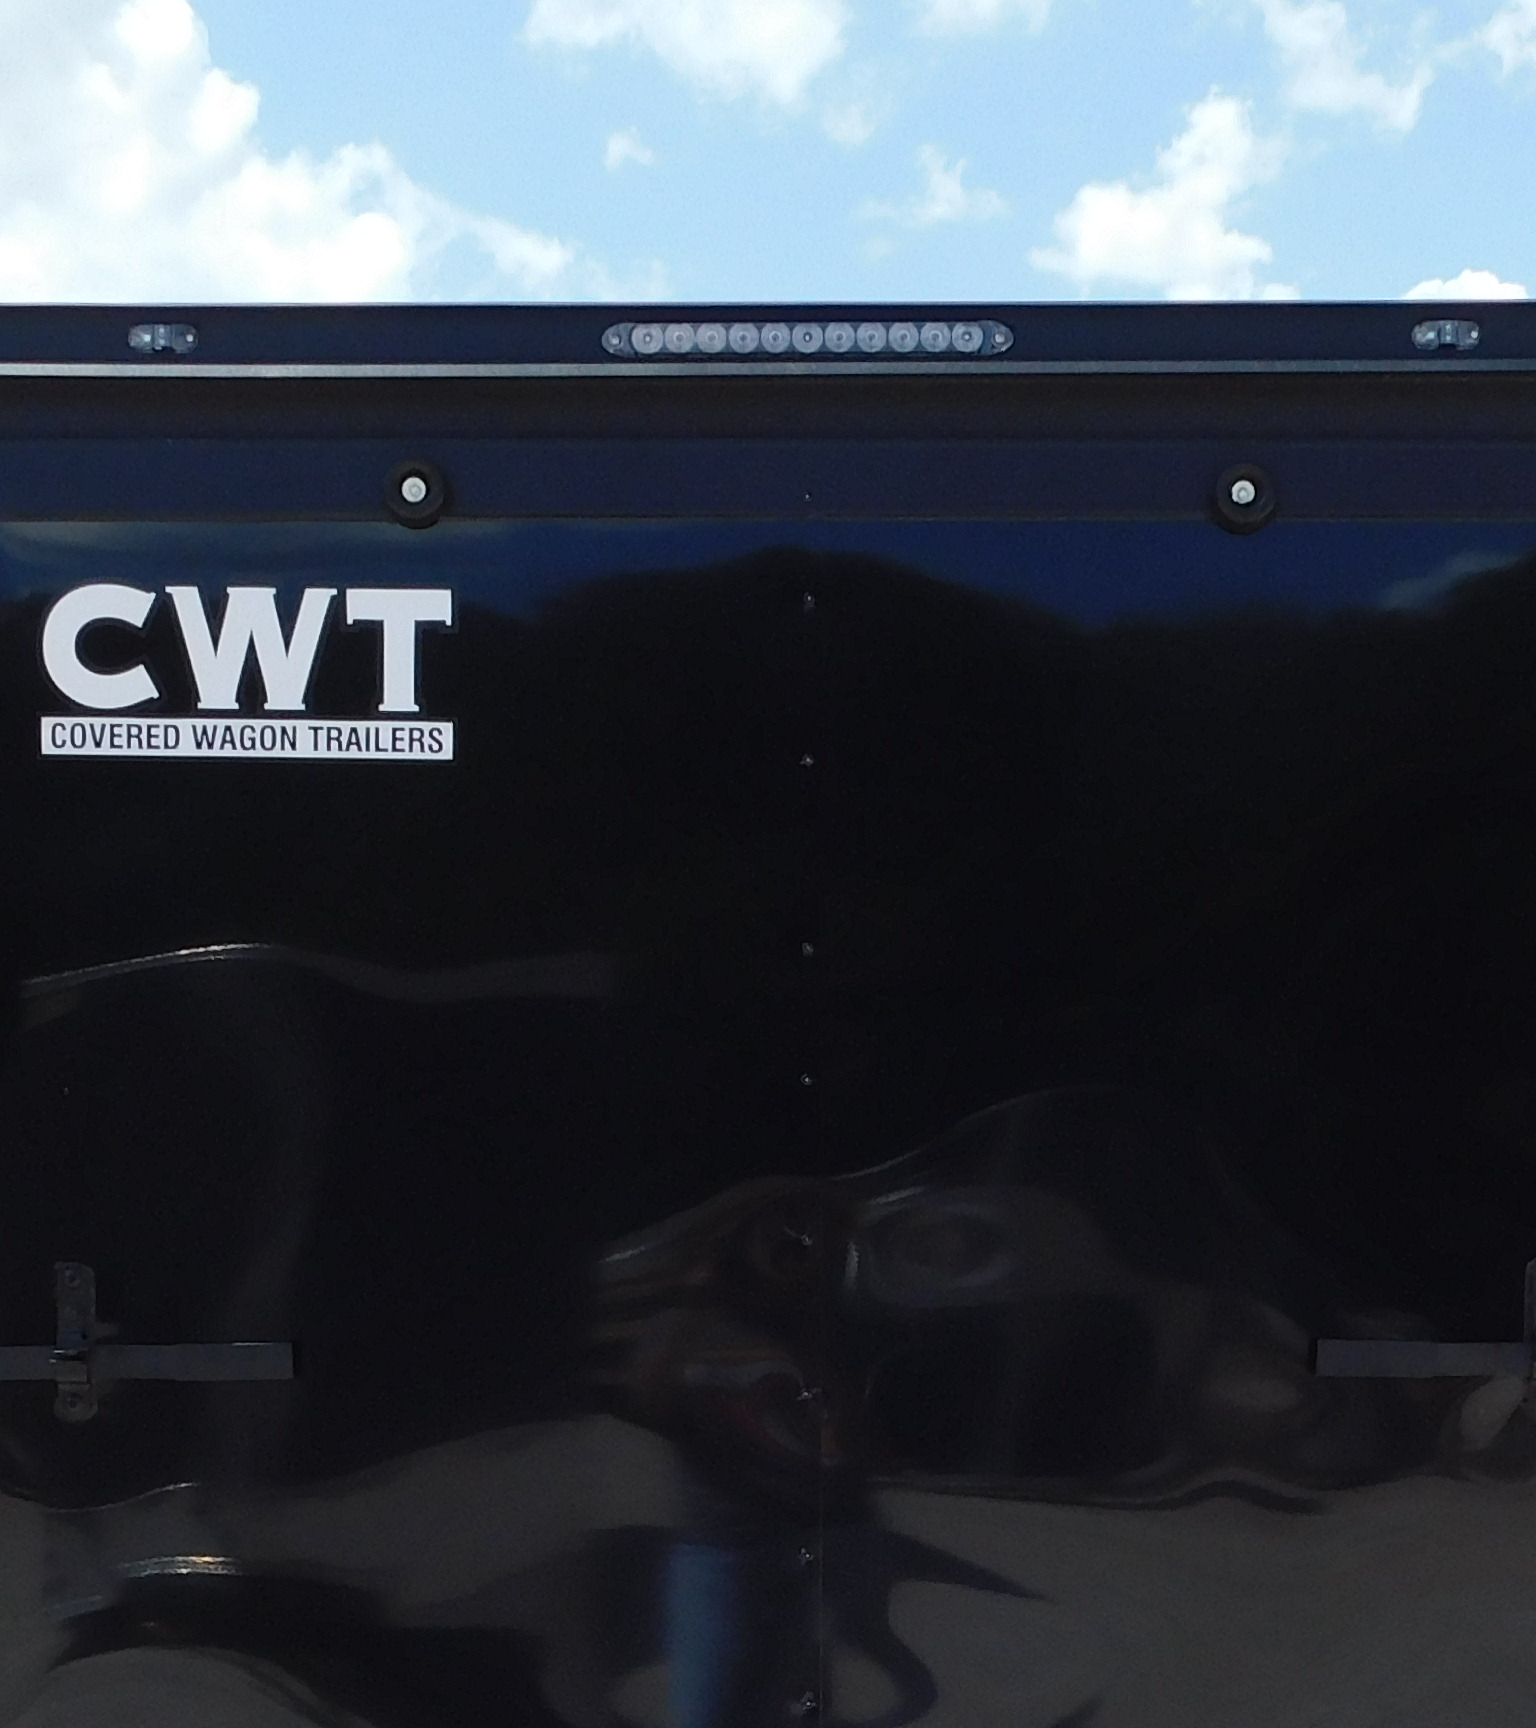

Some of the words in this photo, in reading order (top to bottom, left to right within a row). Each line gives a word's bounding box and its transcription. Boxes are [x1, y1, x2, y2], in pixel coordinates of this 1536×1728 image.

[43, 583, 452, 712] CWT
[50, 723, 181, 750] COVERED
[192, 725, 298, 752] WAGON
[309, 727, 444, 754] TRAILERS
